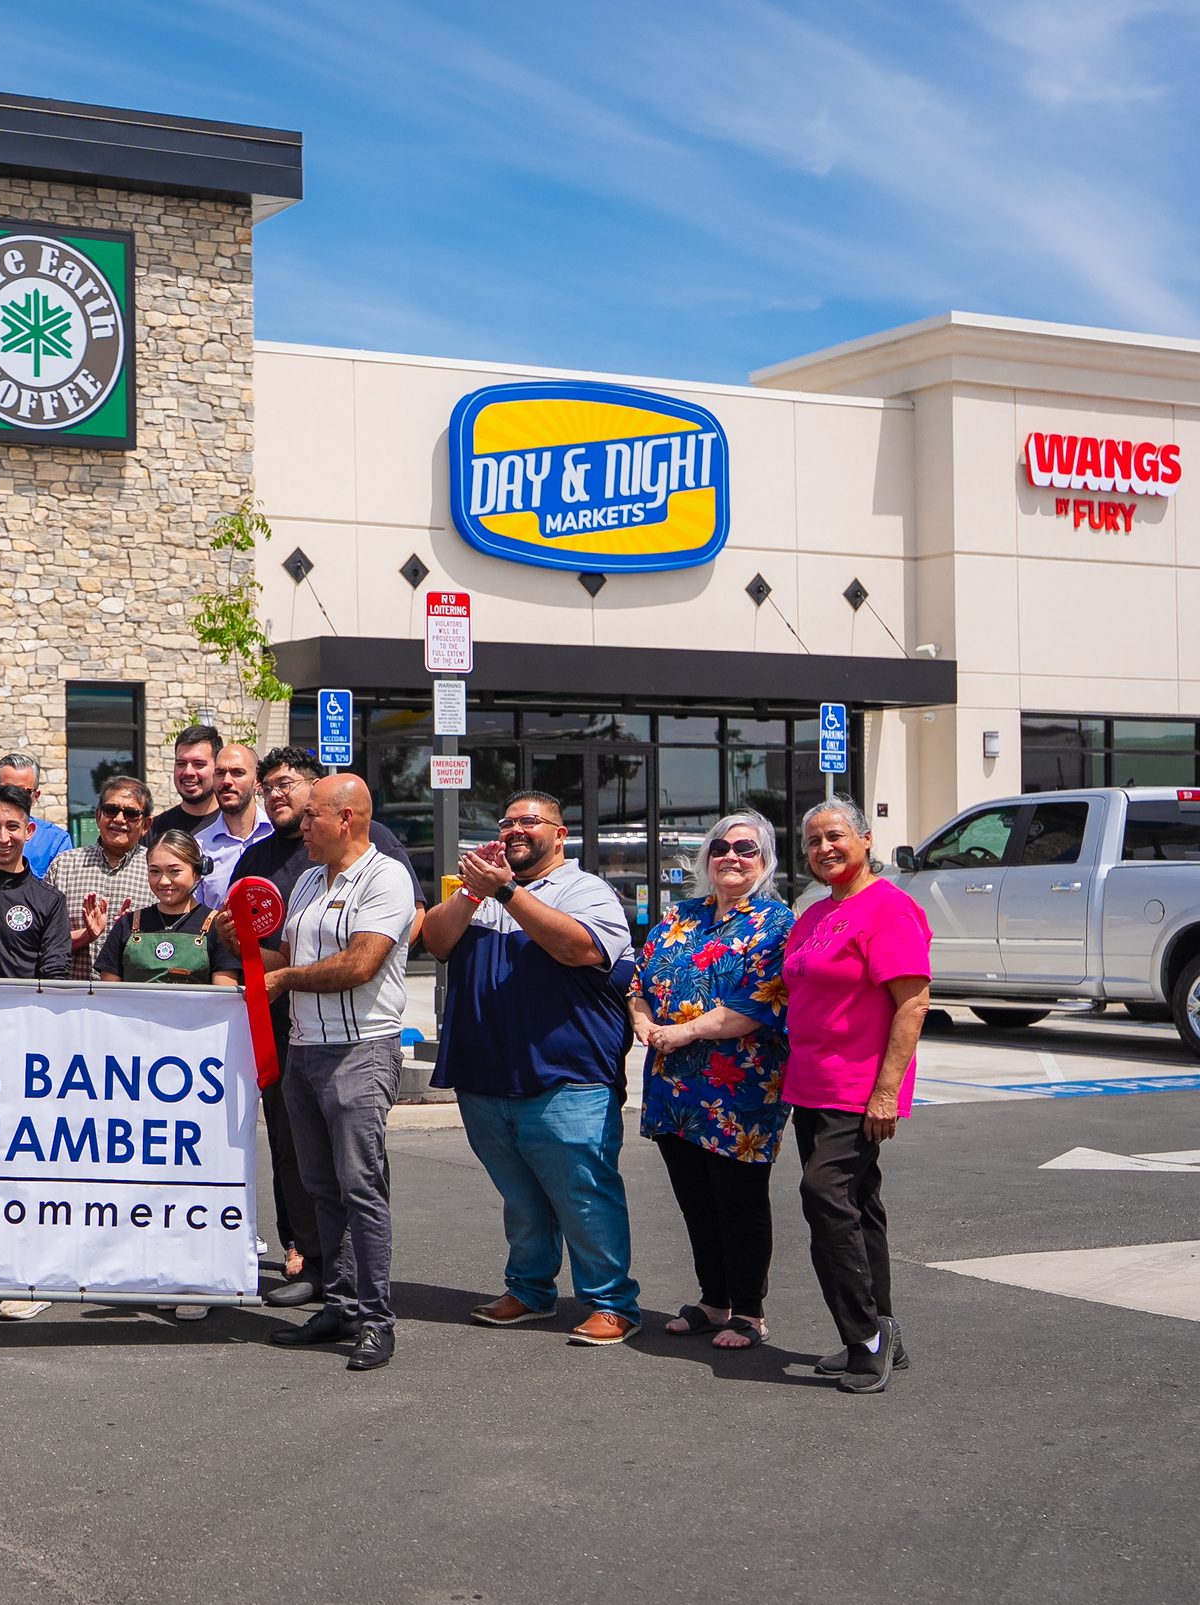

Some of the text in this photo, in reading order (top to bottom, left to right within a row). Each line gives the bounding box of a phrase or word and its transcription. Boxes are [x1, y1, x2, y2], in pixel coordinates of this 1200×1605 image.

[37, 243, 116, 340] Earth
[470, 431, 717, 516] DAY & NIGHT
[1029, 432, 1182, 490] WANGS
[545, 502, 645, 534] MARKETS
[1055, 498, 1138, 532] BY FURY
[429, 605, 467, 615] LOITERING
[822, 730, 844, 740] PARKING
[826, 741, 839, 750] ONLY
[24, 1053, 225, 1104] BANOS
